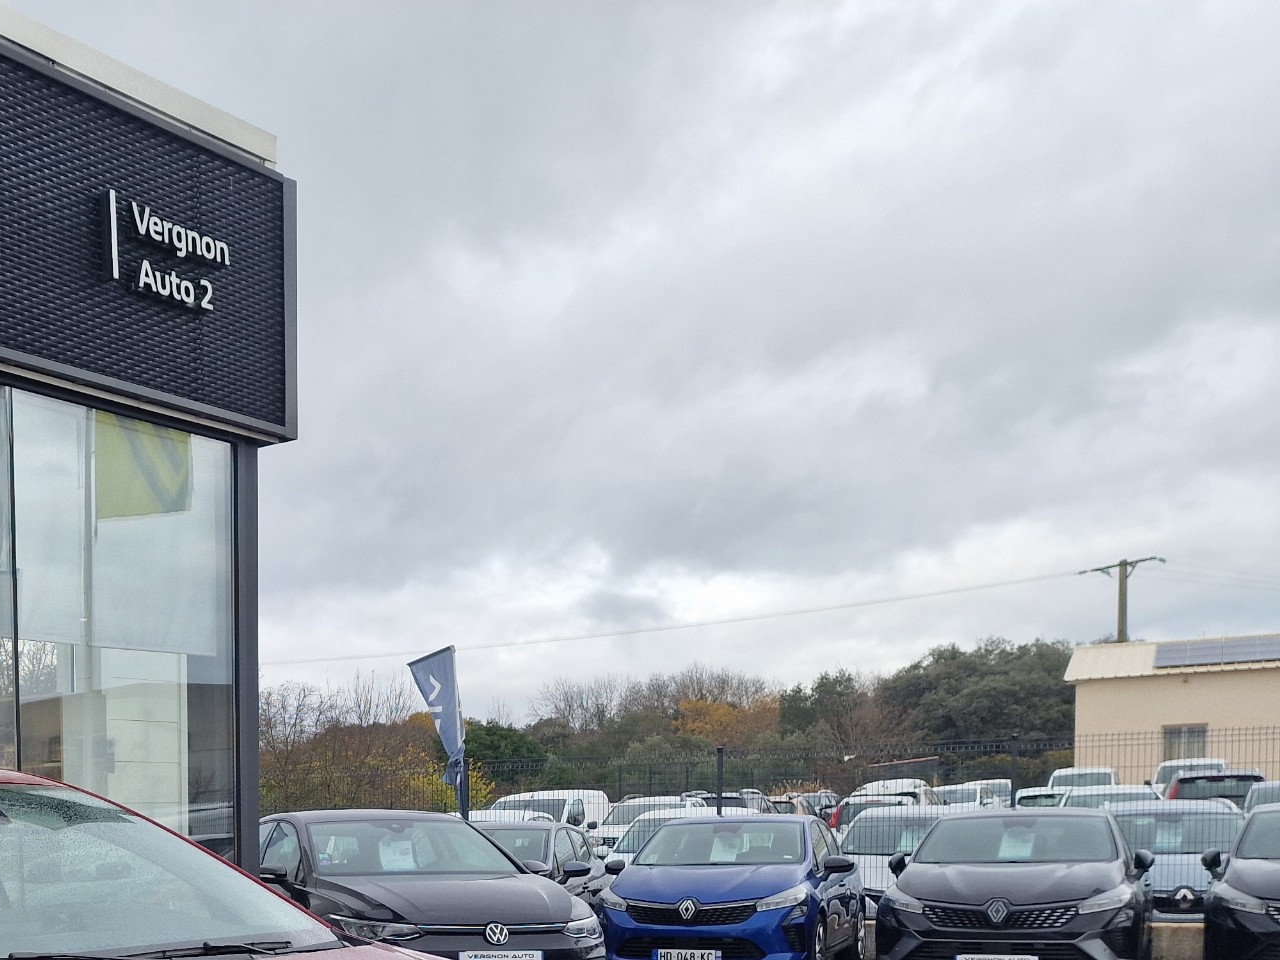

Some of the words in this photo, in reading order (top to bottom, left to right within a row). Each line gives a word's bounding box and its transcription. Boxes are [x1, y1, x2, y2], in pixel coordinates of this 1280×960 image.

[131, 200, 230, 266] Vergnon
[138, 259, 195, 304] Auto
[200, 279, 214, 310] 2
